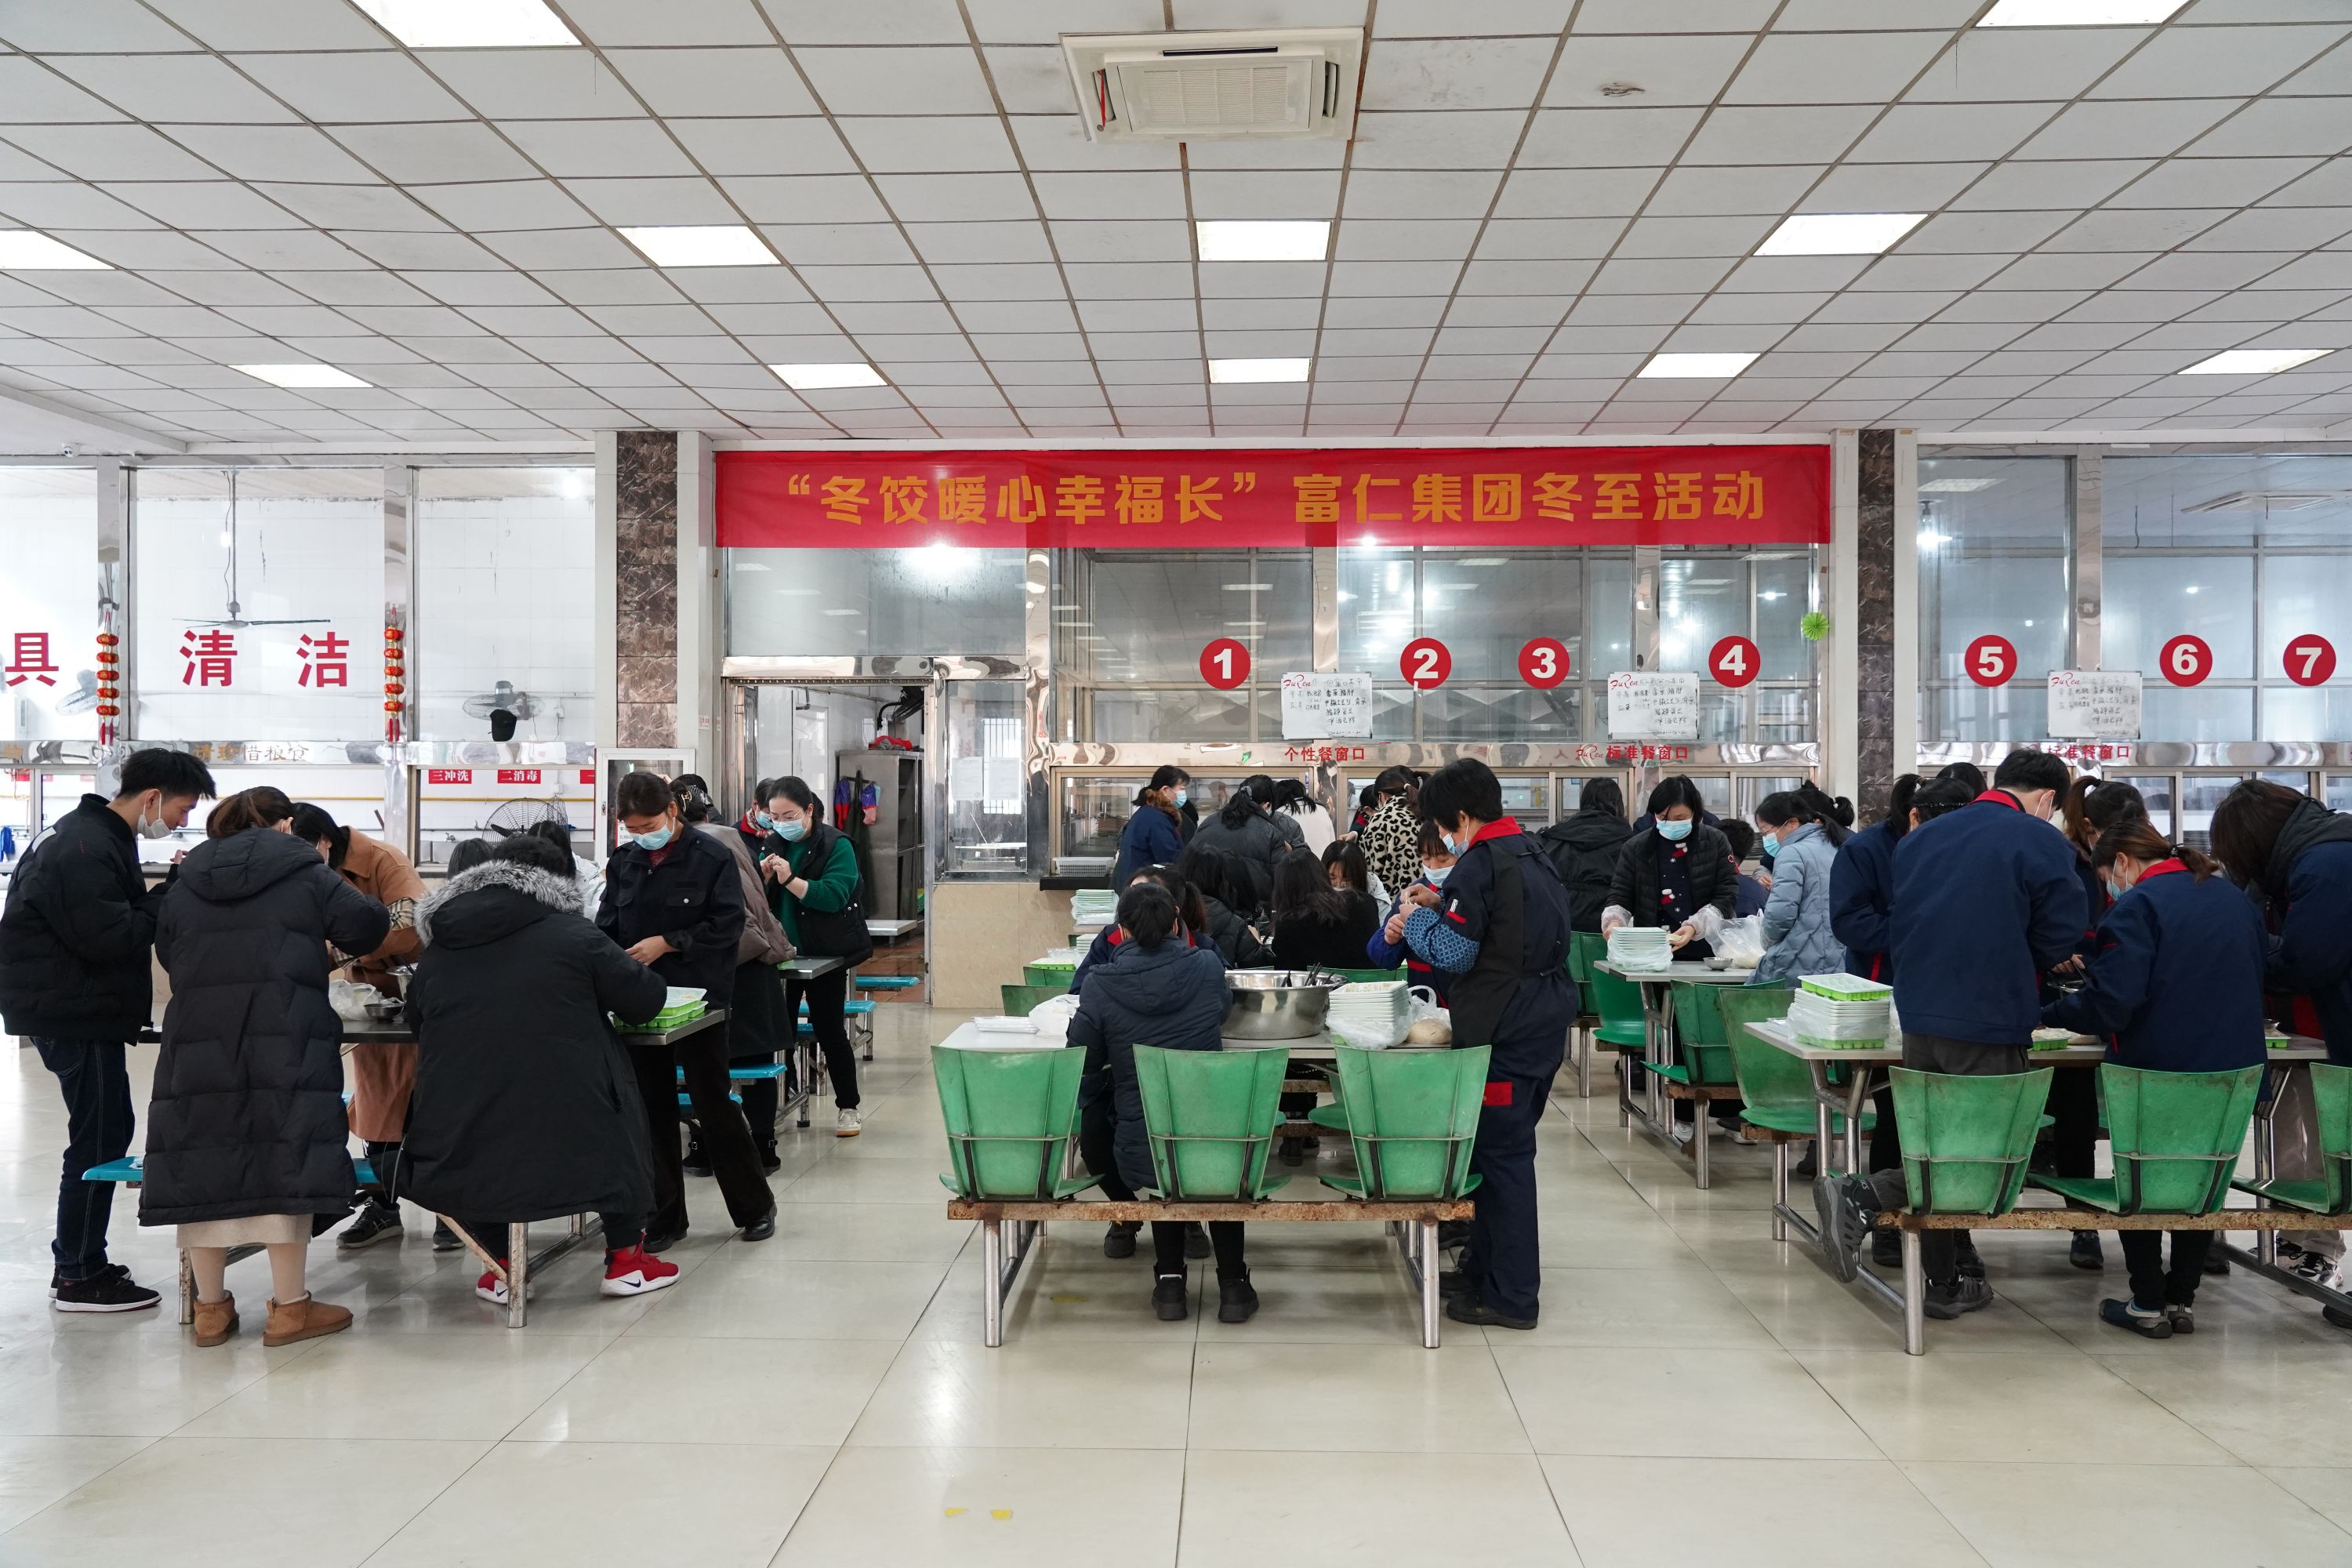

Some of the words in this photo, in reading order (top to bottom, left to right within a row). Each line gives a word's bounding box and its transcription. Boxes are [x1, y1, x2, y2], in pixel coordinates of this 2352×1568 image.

[788, 473, 1254, 524] “冬饺暖心幸福长”
[1294, 471, 1764, 523] 富仁集团冬至活动
[5, 632, 59, 687] 具
[180, 630, 350, 688] 清洁
[1213, 648, 1232, 679] 1
[1414, 648, 1438, 679] 2
[1531, 648, 1556, 678] 3
[1719, 645, 1747, 676] 4
[1978, 647, 2004, 677] 5
[2172, 644, 2198, 675] 6
[2296, 648, 2322, 678] 7
[193, 743, 309, 761] 请珍惜粮食
[1284, 746, 1366, 762] 个性餐窗口
[1606, 745, 1688, 760] 标准餐窗口
[432, 770, 469, 782] 三冲洗
[501, 770, 538, 782] 二消毒
